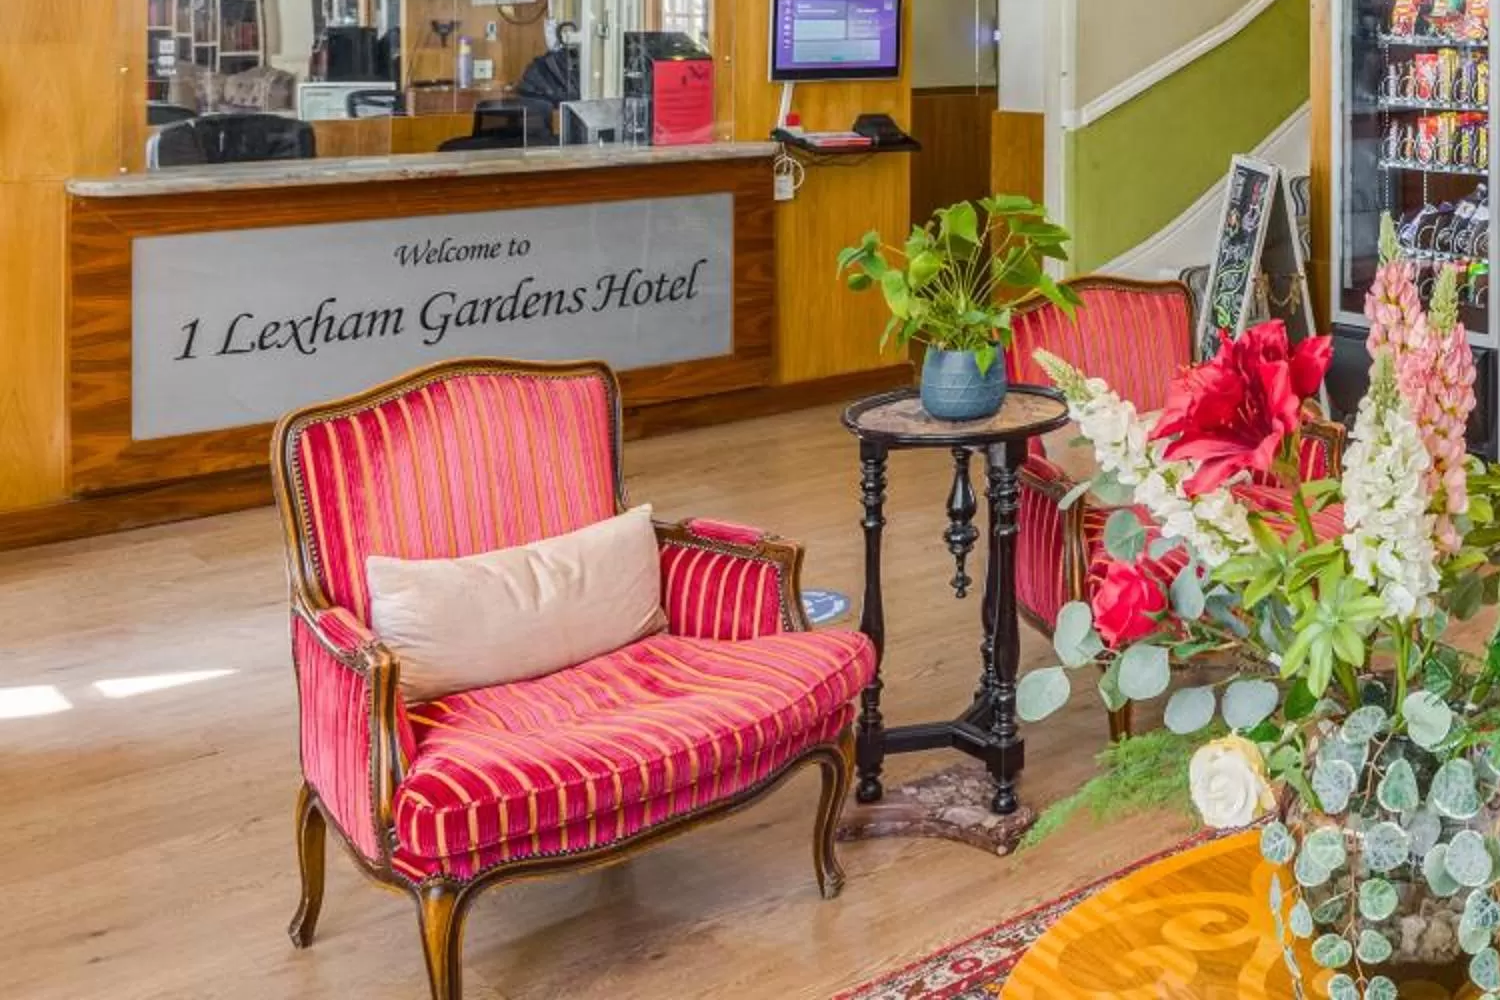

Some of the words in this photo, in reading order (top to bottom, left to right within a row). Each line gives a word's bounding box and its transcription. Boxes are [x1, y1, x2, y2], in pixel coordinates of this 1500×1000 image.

[393, 237, 502, 267] Welcome
[508, 237, 532, 257] to
[173, 318, 200, 361] 1
[213, 297, 405, 355] Lexham
[419, 276, 587, 345] Gardens
[592, 258, 708, 313] Hotel
